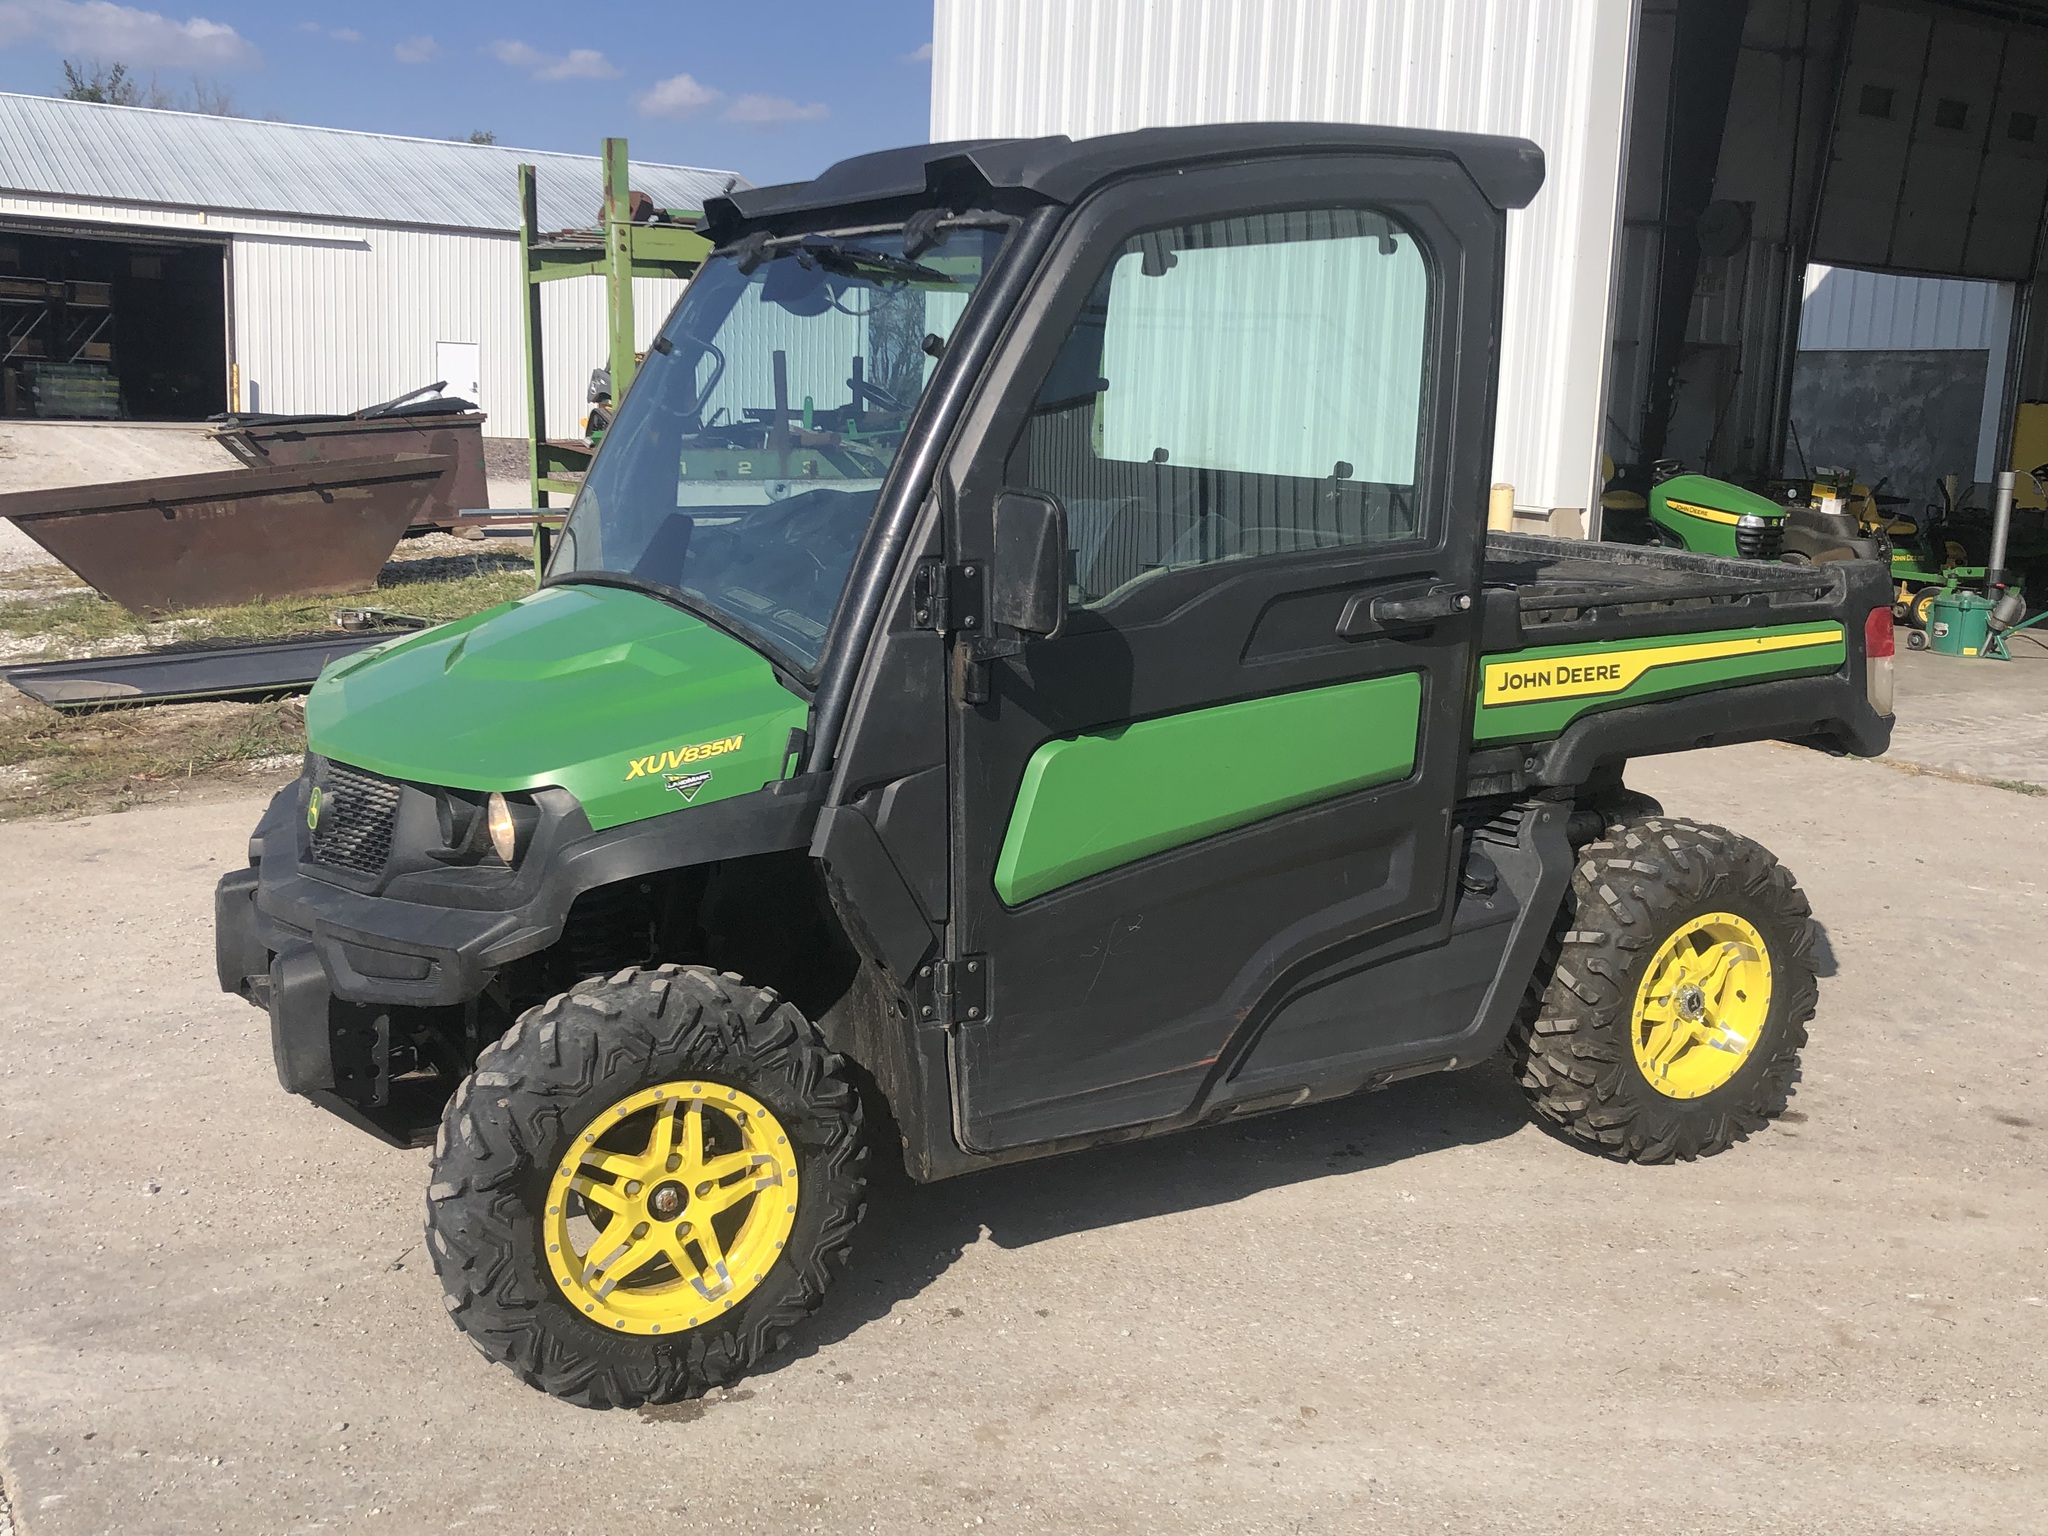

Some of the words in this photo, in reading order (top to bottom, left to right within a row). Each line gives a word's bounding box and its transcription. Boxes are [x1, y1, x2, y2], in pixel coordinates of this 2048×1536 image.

[680, 461, 687, 475] 1
[738, 461, 752, 474] 2
[1675, 504, 1690, 512] JOHN
[1690, 507, 1708, 516] DEERE
[1498, 671, 1551, 691] JOHN
[1556, 664, 1621, 685] DEERE
[625, 735, 743, 780] XUV835M
